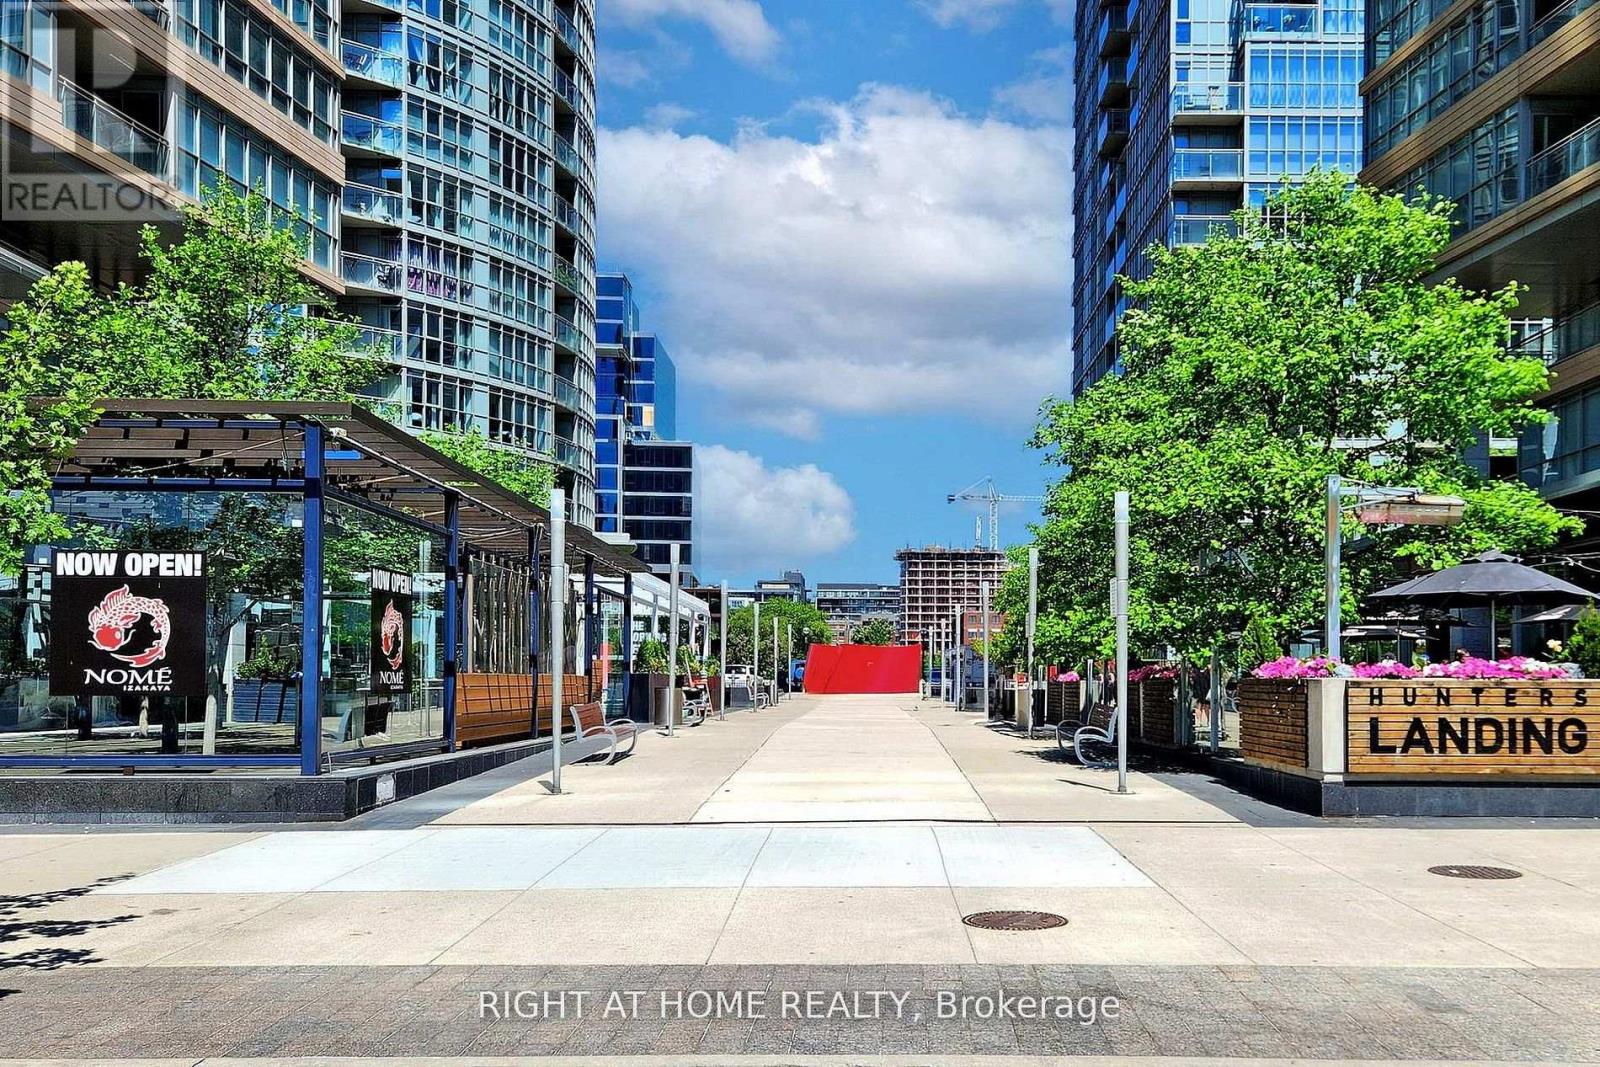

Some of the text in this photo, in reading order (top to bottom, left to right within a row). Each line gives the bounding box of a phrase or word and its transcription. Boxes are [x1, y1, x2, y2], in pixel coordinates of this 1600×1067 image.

[56, 552, 203, 577] NOW OPEN!
[372, 568, 412, 595] NOW OPEN!
[83, 666, 173, 685] NOMÉ
[379, 669, 405, 685] NOMÉ
[122, 684, 171, 692] IZAKAYA
[1369, 686, 1588, 707] HUNTERS
[1369, 716, 1588, 755] LANDING
